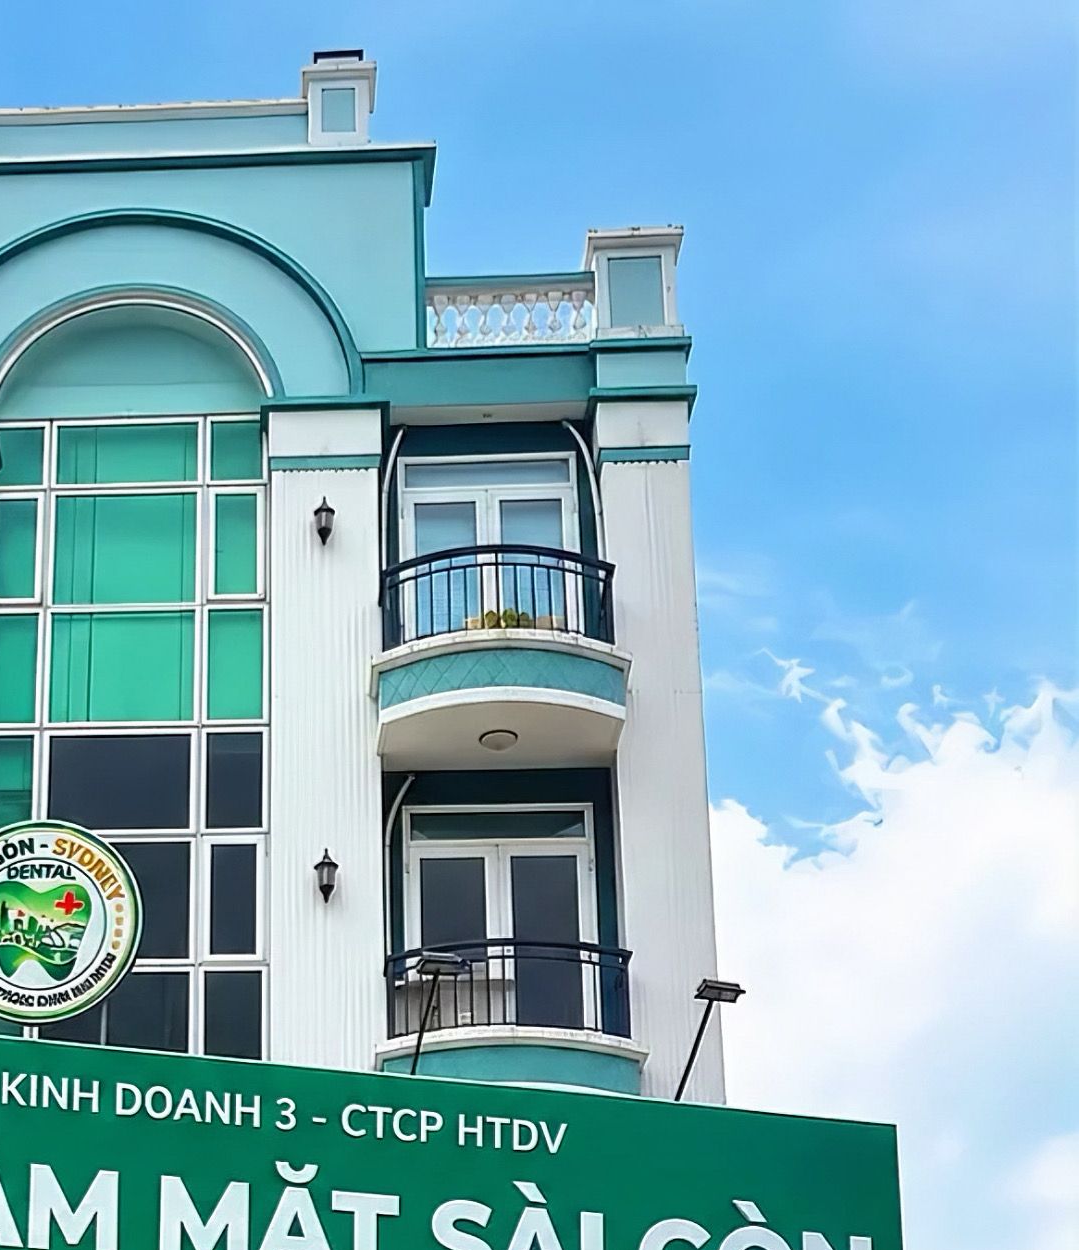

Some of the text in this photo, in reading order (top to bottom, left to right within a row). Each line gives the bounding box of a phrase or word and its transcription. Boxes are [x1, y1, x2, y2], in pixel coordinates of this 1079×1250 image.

[7, 864, 76, 880] DENTAL
[1, 1072, 99, 1113] KINH
[114, 1082, 262, 1128] DOANH
[274, 1097, 297, 1130] 3
[340, 1103, 444, 1143] CTCP
[457, 1113, 568, 1154] HTDV
